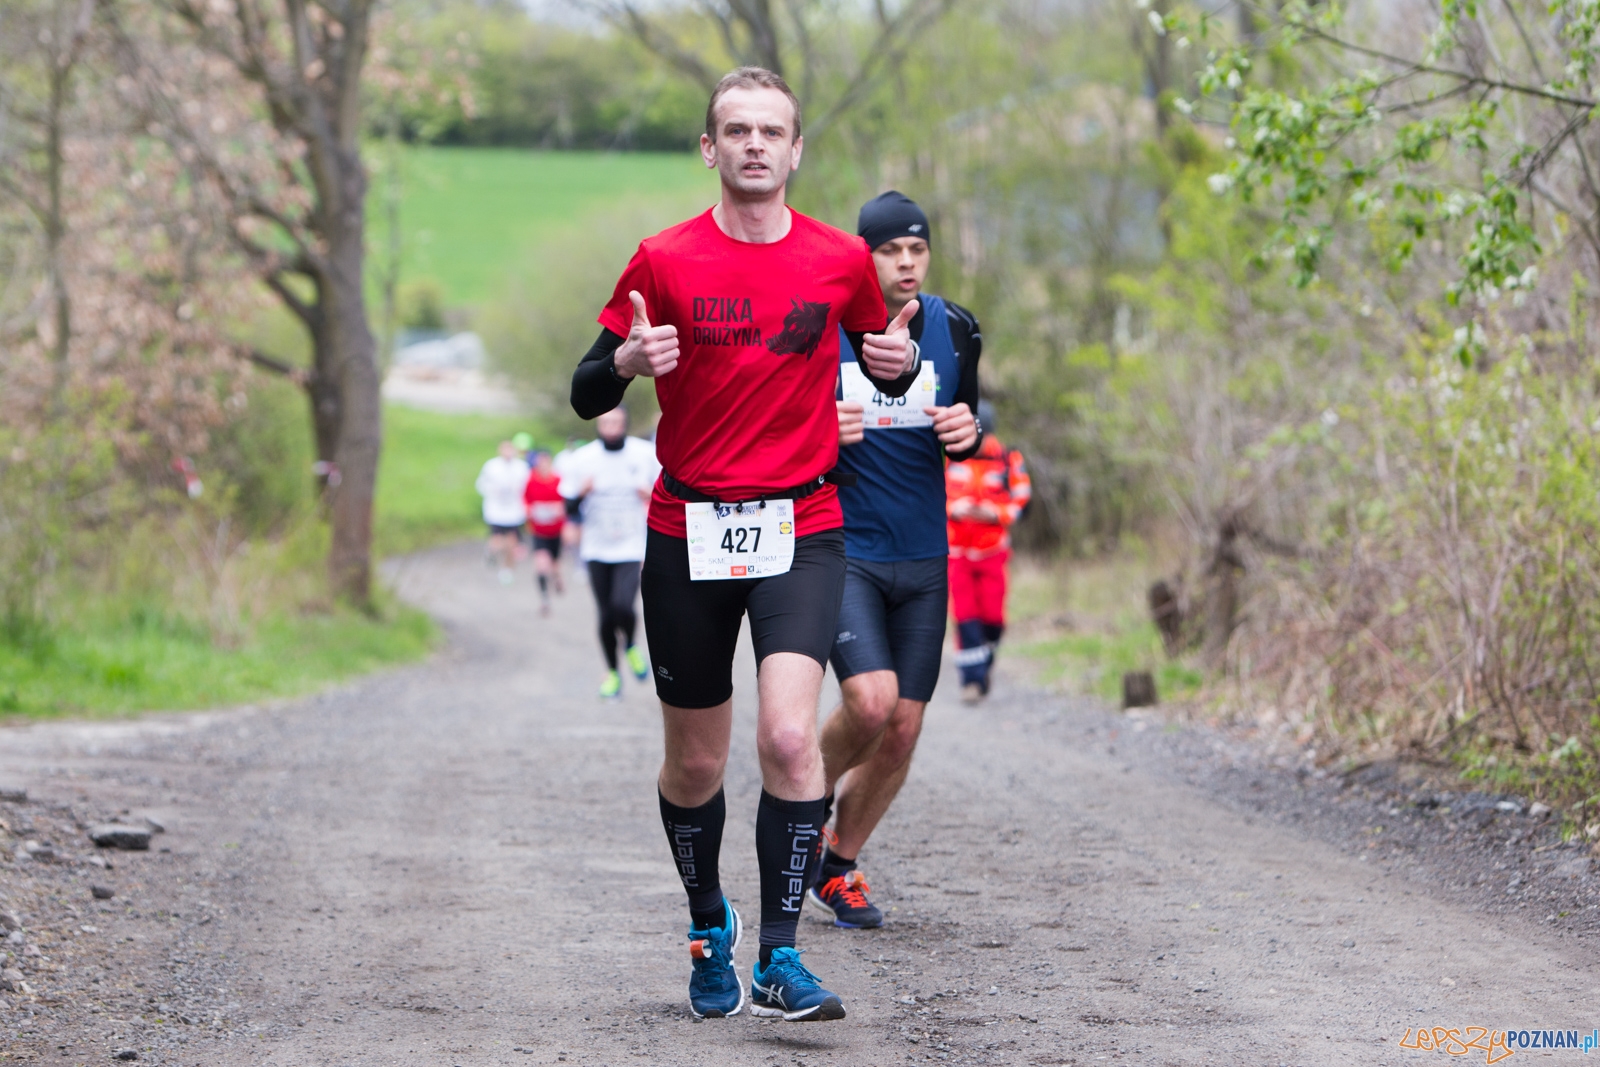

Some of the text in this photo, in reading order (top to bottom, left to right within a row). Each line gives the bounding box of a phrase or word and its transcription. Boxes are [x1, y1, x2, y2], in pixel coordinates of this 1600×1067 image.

[693, 297, 754, 323] DZIKA
[694, 324, 762, 347] DRUŻYNA
[721, 527, 762, 554] 427
